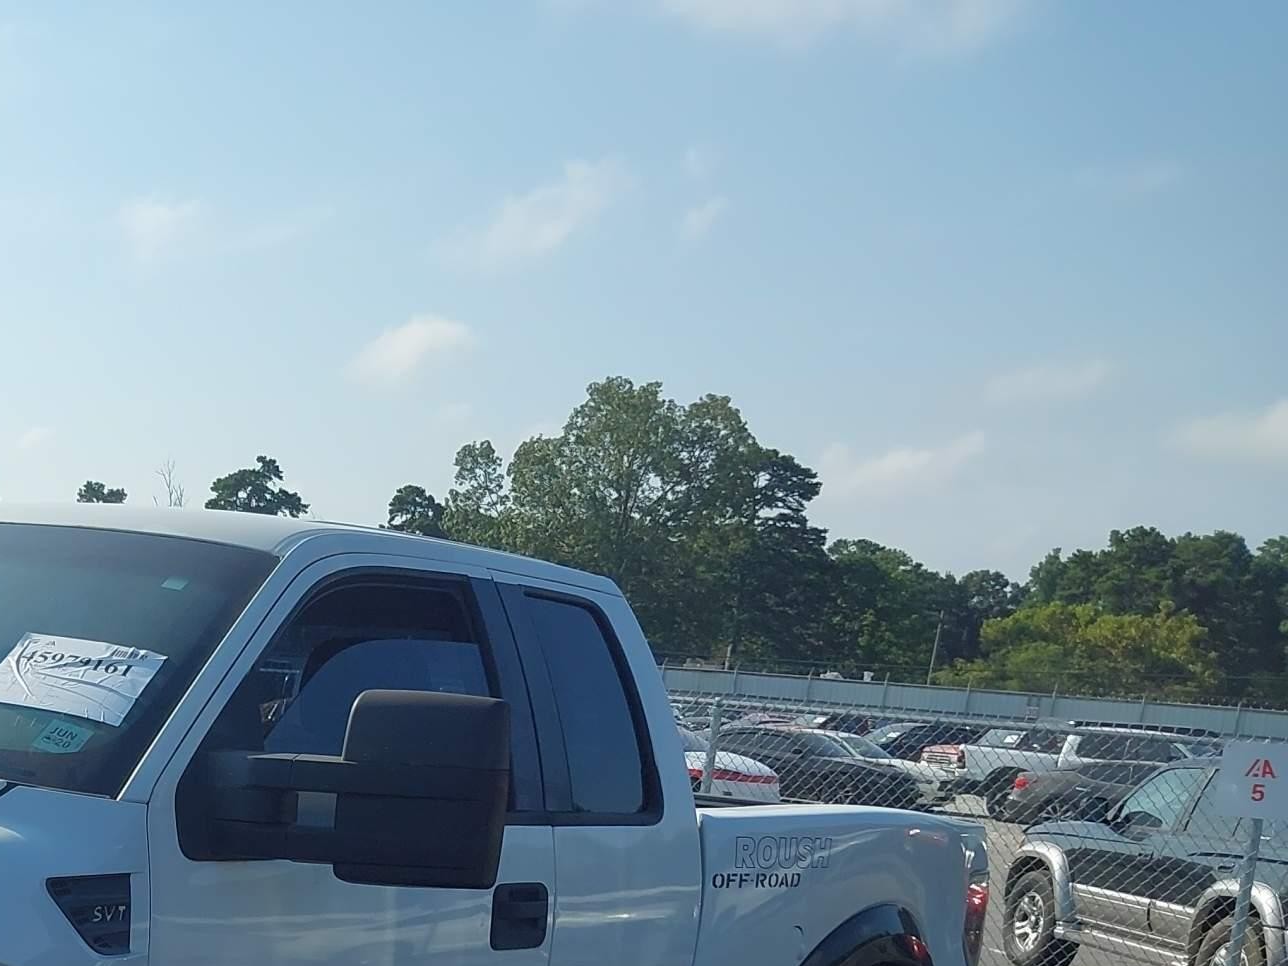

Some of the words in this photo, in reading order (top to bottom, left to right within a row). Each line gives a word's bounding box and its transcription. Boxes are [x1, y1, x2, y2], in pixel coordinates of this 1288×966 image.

[49, 727, 78, 741] JUN
[1251, 783, 1265, 802] 5
[734, 836, 832, 869] ROUSH
[712, 872, 801, 888] OFF-ROAD
[92, 905, 126, 922] SVT
